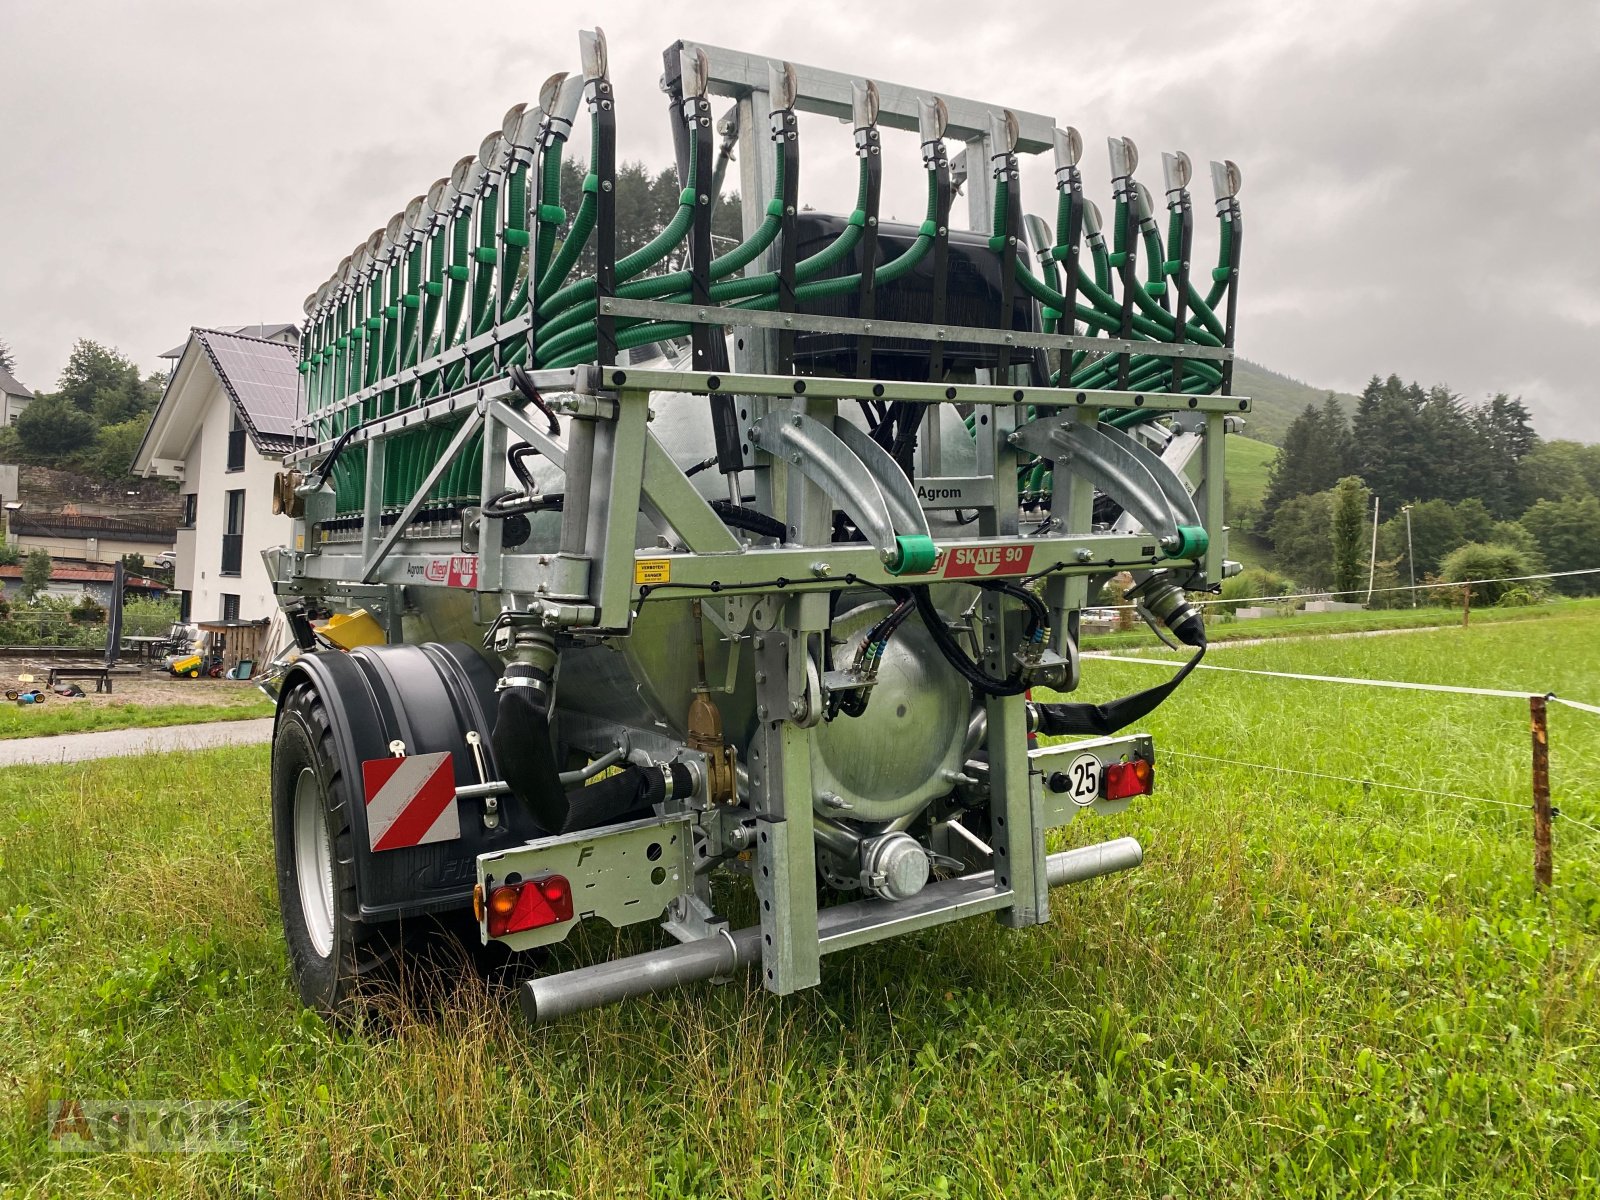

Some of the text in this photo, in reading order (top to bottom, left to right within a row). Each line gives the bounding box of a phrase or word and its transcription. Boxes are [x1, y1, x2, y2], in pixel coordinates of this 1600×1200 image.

[917, 486, 962, 501] Agrom
[956, 547, 1002, 565] SKATE
[1005, 547, 1023, 562] 90
[407, 562, 424, 577] Agrom
[453, 558, 474, 574] SKATE
[1074, 761, 1096, 797] 25
